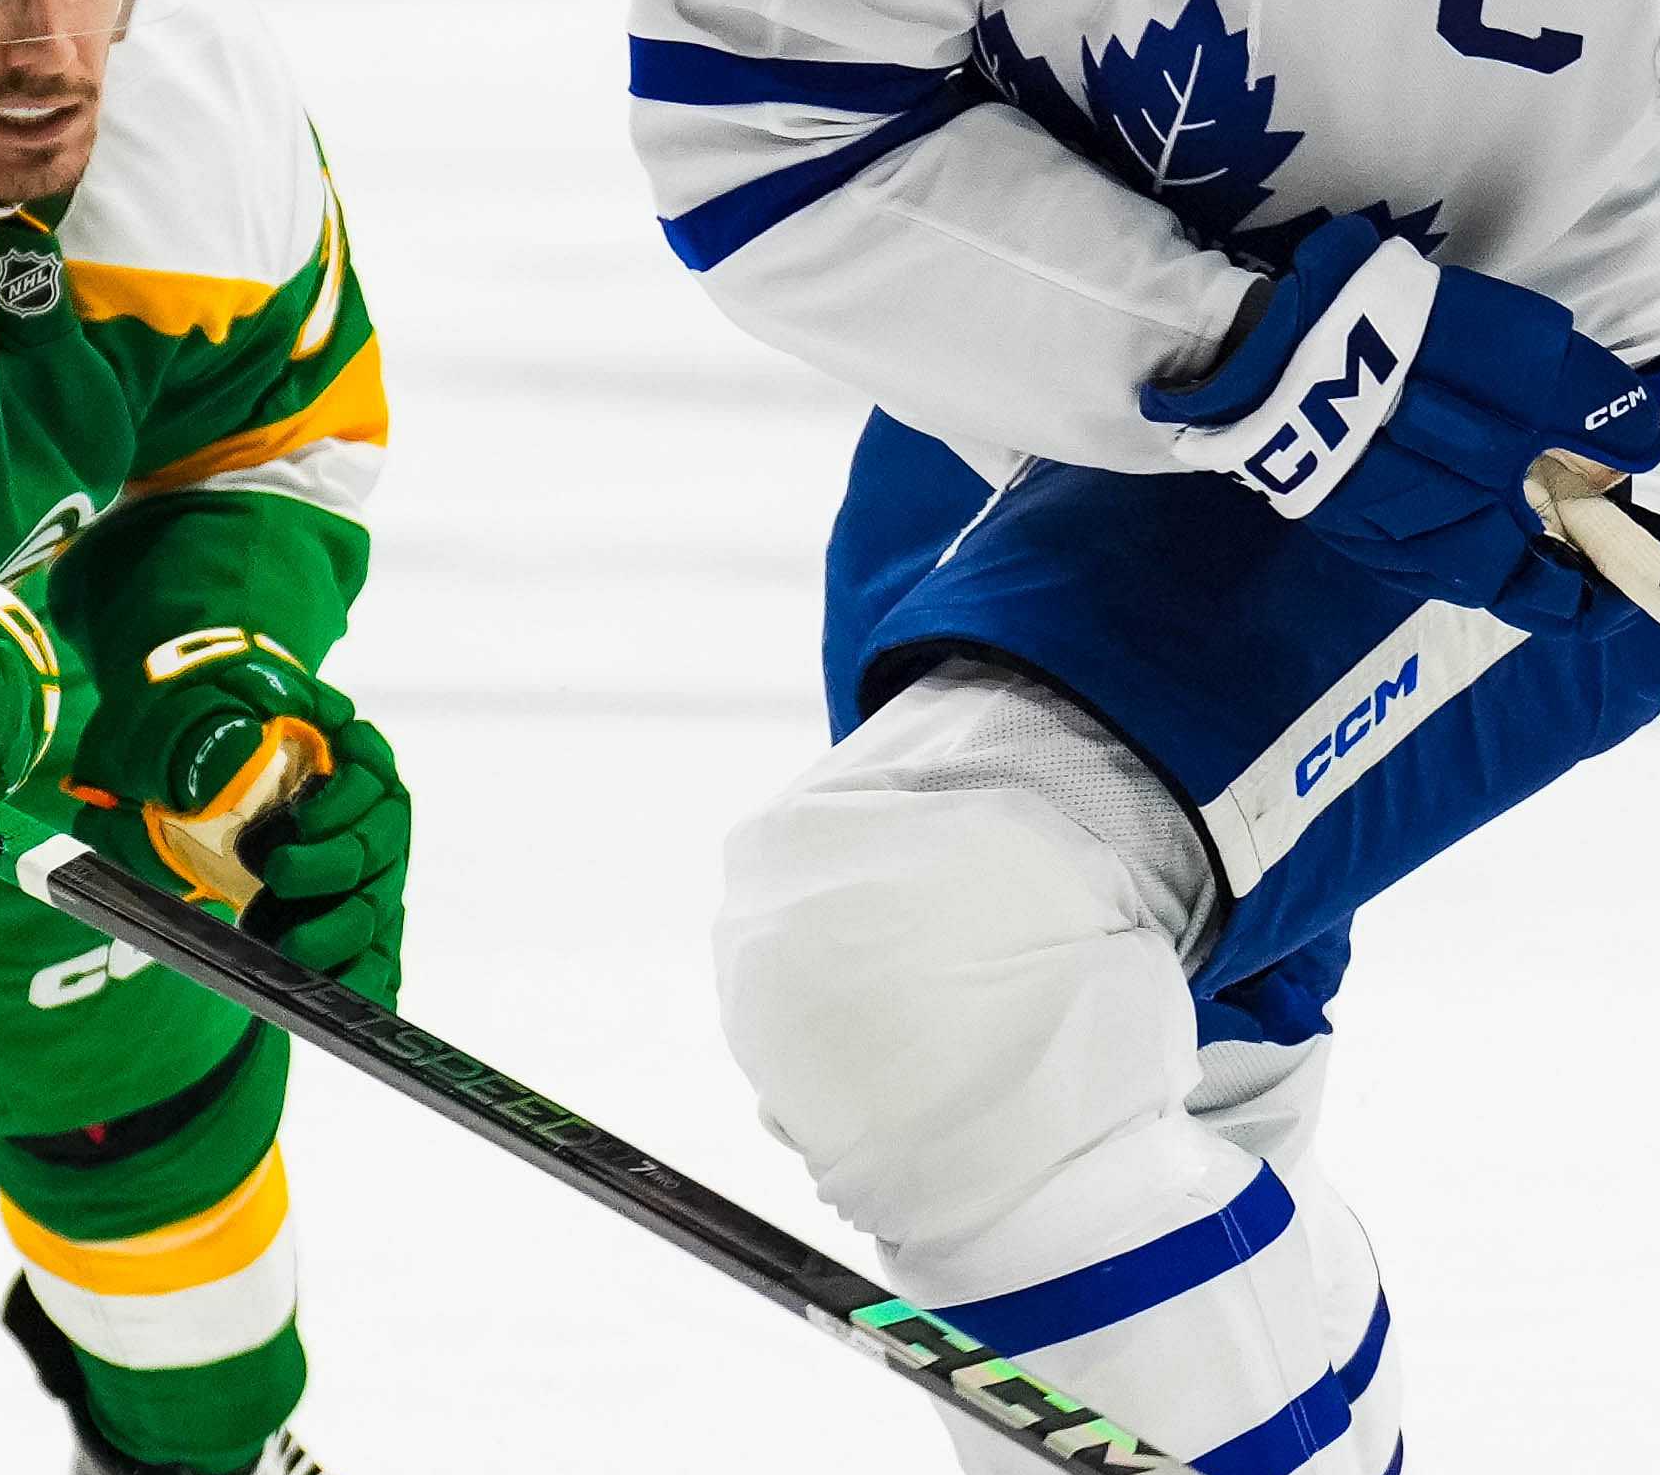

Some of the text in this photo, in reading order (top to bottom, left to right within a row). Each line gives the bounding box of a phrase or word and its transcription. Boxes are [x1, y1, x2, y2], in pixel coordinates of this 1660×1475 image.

[7, 266, 48, 301] NHL
[1585, 386, 1647, 430] CCM
[1295, 652, 1419, 797] CCM
